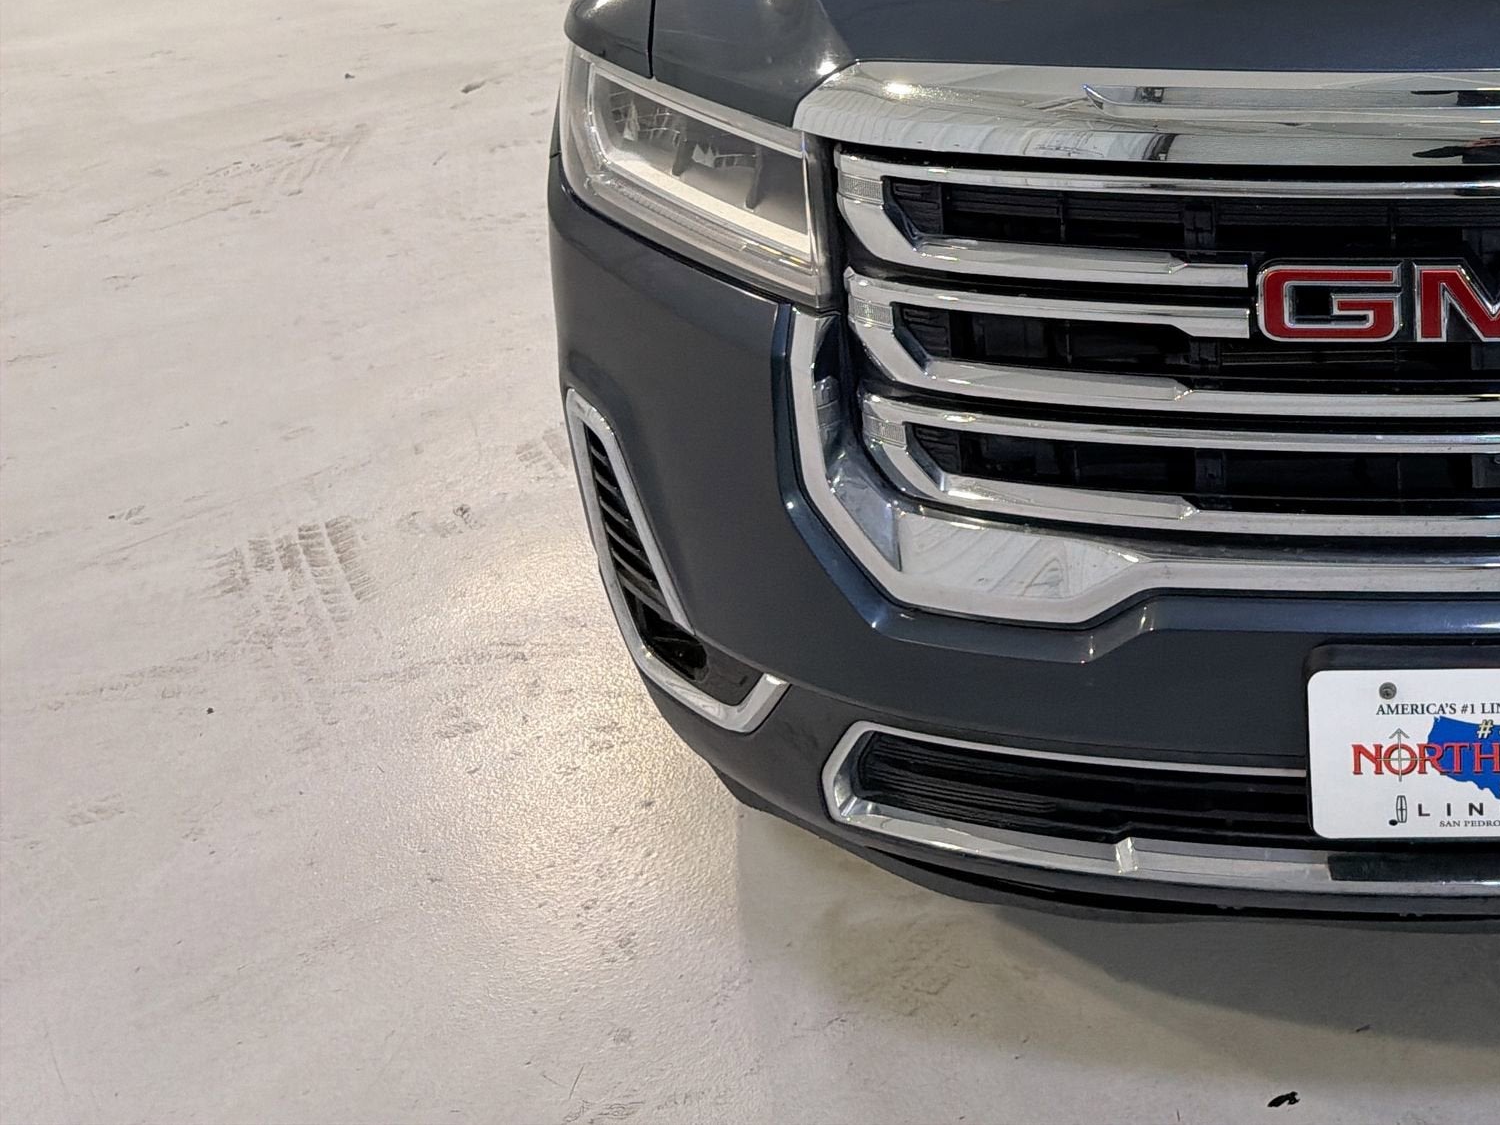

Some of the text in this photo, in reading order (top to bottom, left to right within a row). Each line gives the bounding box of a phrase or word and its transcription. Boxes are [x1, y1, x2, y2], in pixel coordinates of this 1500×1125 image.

[1376, 703, 1457, 715] AMERICA'S
[1460, 703, 1476, 714] #1
[1439, 820, 1460, 828] SAN
[1463, 819, 1500, 828] PEDRO
